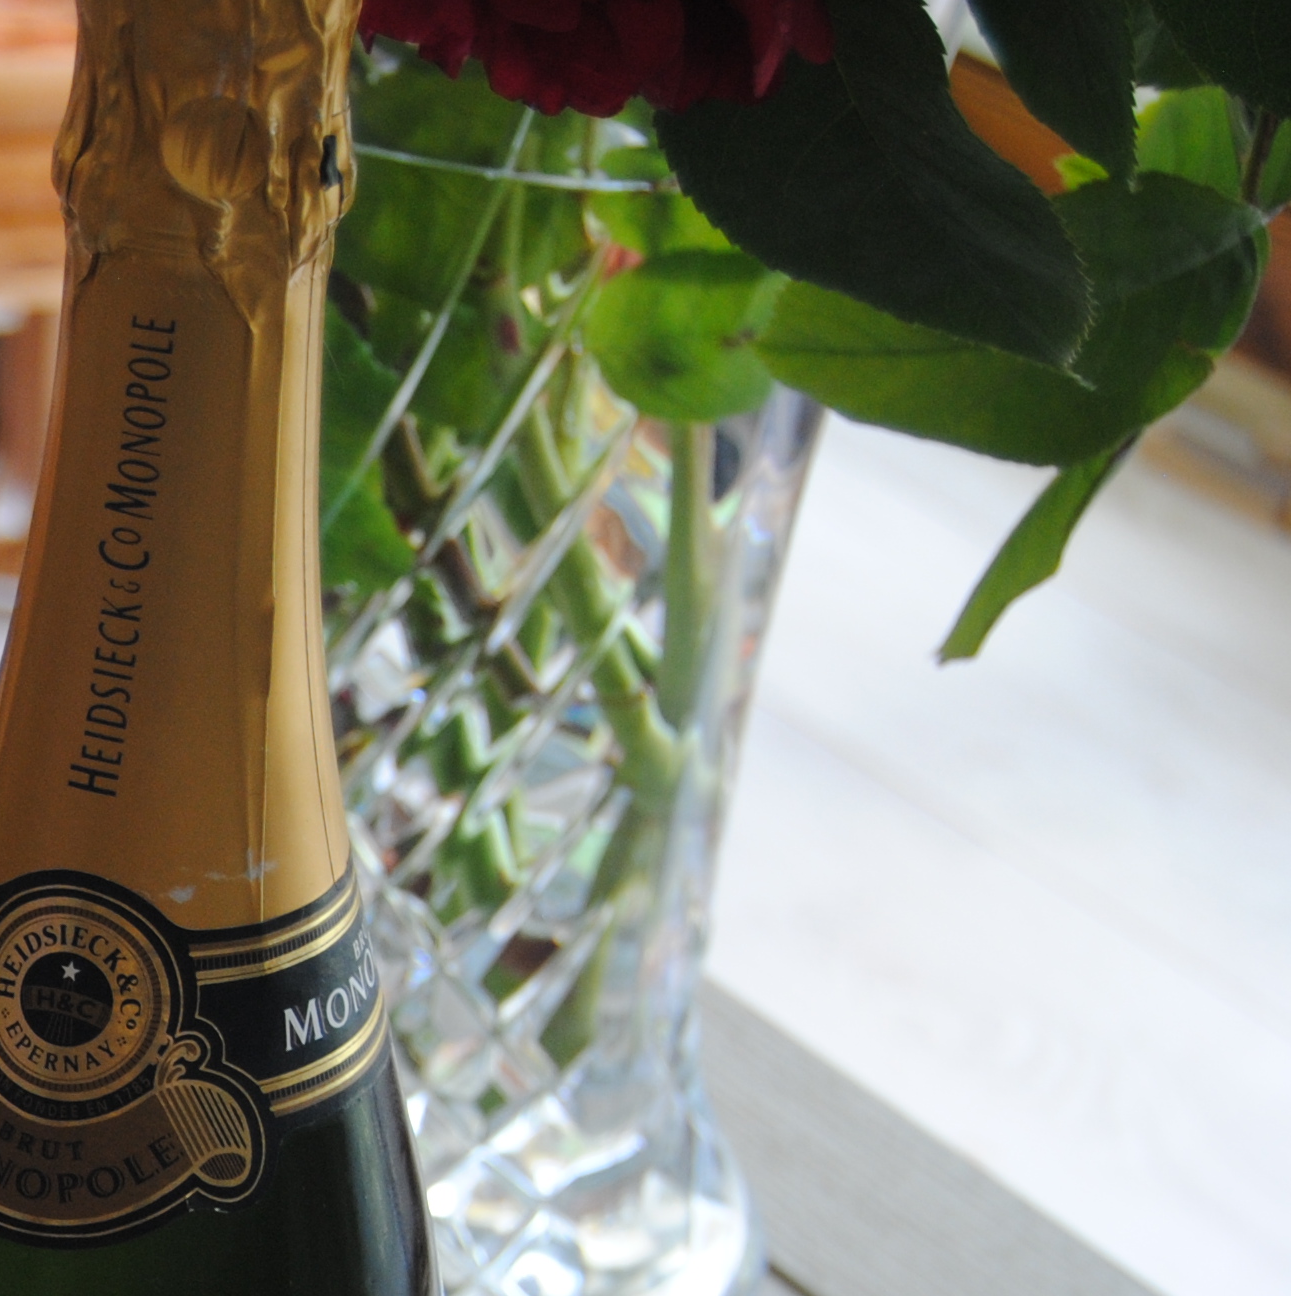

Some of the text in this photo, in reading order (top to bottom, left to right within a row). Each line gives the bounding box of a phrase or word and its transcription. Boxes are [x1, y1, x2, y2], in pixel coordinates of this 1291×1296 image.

[104, 315, 176, 520] MONOPOLE
[67, 597, 143, 798] HEIDSIECK
[4, 1019, 115, 1074] EPERNAY
[37, 988, 98, 1019] H&C
[284, 932, 376, 1051] MONO
